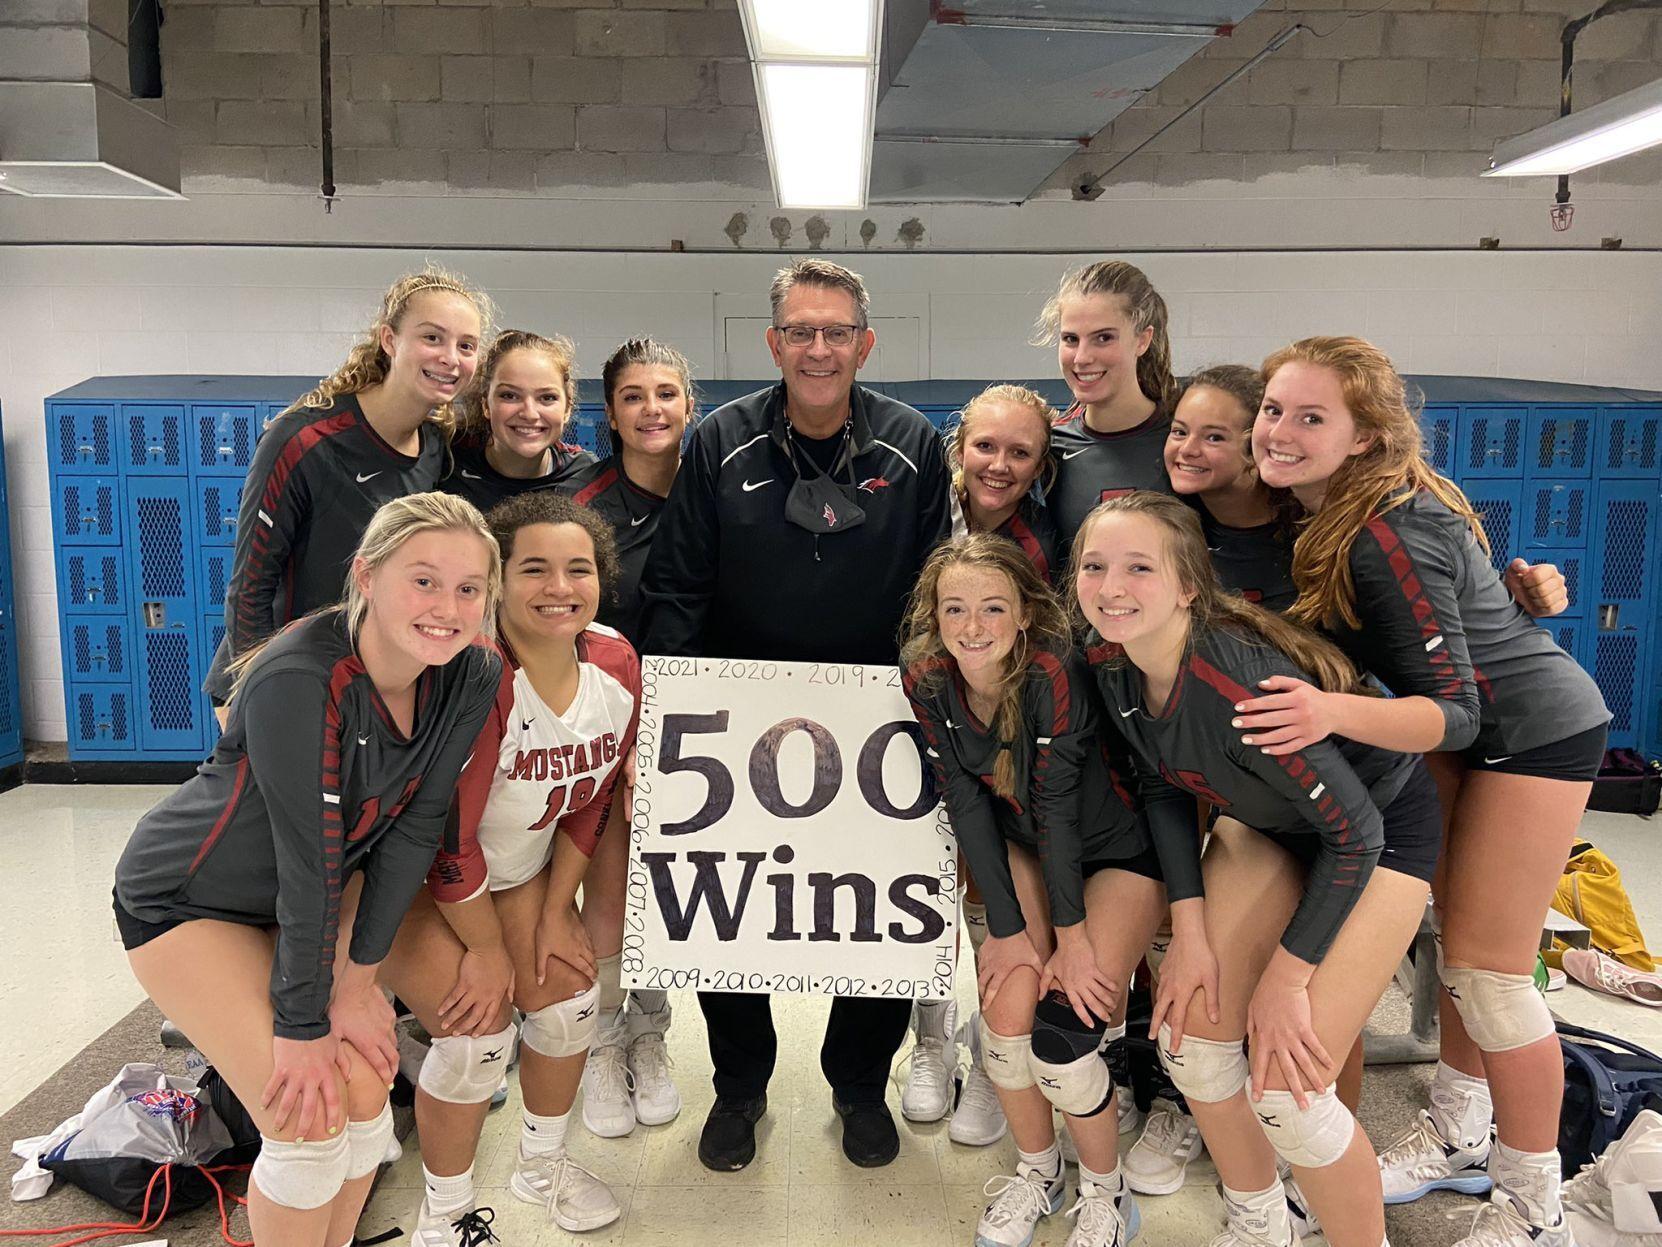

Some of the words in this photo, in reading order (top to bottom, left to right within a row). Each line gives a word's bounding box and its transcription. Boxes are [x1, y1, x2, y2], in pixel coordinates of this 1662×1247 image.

[640, 658, 658, 707] 2004
[657, 657, 698, 677] 2021
[717, 659, 778, 681] 2020
[807, 664, 865, 688] 2019
[506, 731, 621, 782] MUSTANG
[637, 718, 657, 769] 2005
[657, 709, 943, 837] 500
[630, 781, 652, 844] 2006
[628, 857, 648, 911] 2007
[639, 844, 946, 944] Wins
[936, 858, 957, 905] 2015
[621, 917, 645, 974] 2008
[932, 945, 953, 991] 2014
[646, 966, 701, 989] 2009
[712, 970, 764, 990] 2010
[772, 973, 812, 993] 2011
[821, 975, 868, 996] 2012
[881, 978, 930, 999] 2013
